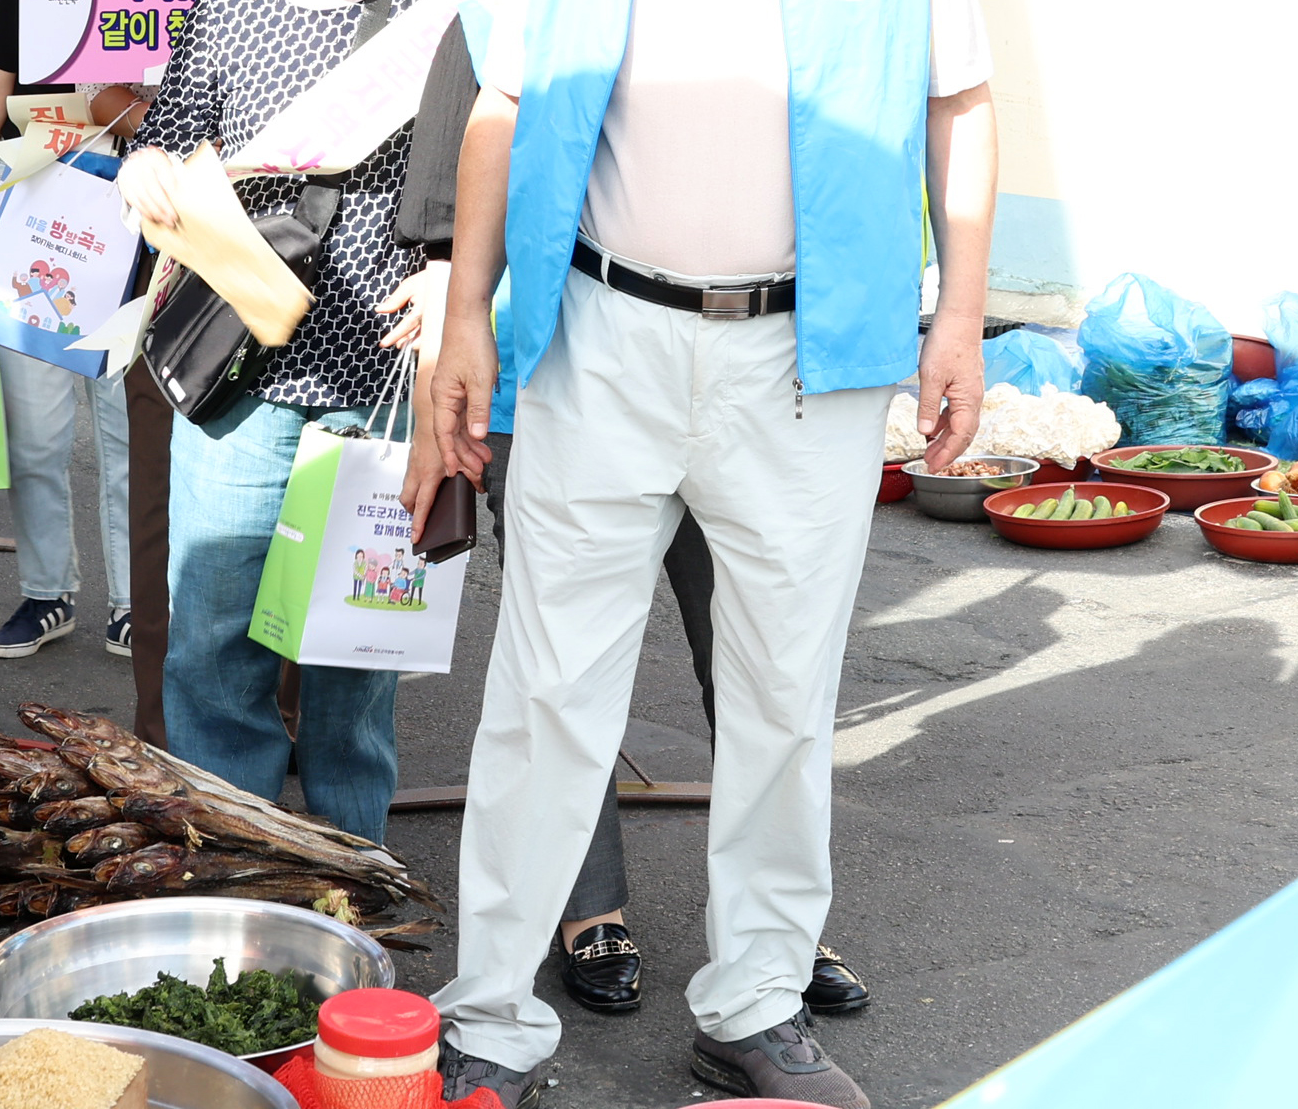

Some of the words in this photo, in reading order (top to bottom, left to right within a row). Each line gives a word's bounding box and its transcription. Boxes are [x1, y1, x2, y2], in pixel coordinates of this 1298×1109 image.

[100, 10, 157, 50] 같이
[25, 215, 48, 233] 마을
[49, 219, 106, 256] 방방곡곡
[31, 234, 55, 251] 찾아가는
[68, 250, 88, 263] 서비스
